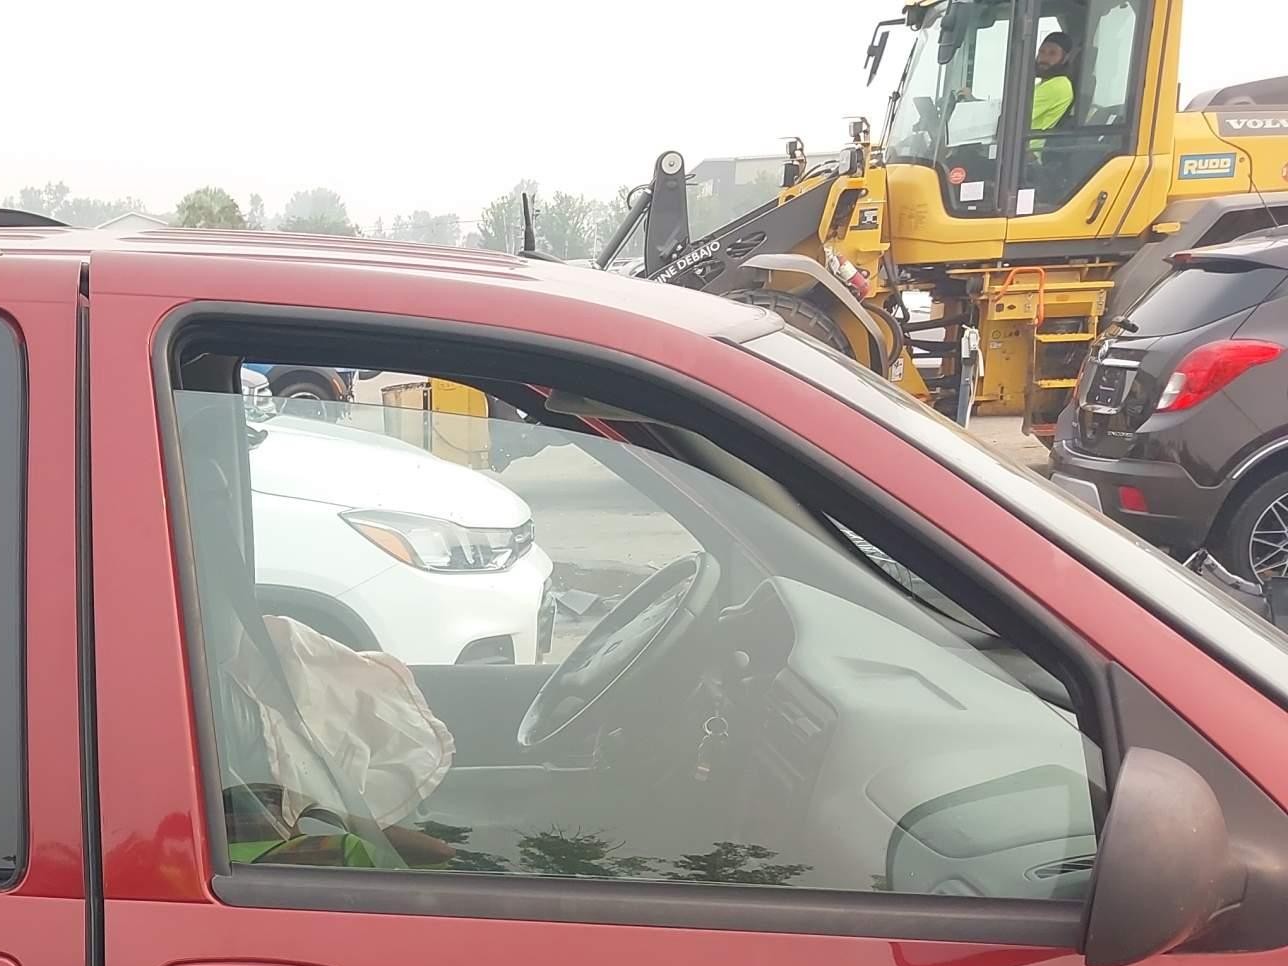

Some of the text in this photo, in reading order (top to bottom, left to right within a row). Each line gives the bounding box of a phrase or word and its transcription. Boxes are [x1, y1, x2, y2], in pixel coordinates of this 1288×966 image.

[1183, 157, 1233, 176] RUDD
[654, 240, 721, 285] INE DEBAJO
